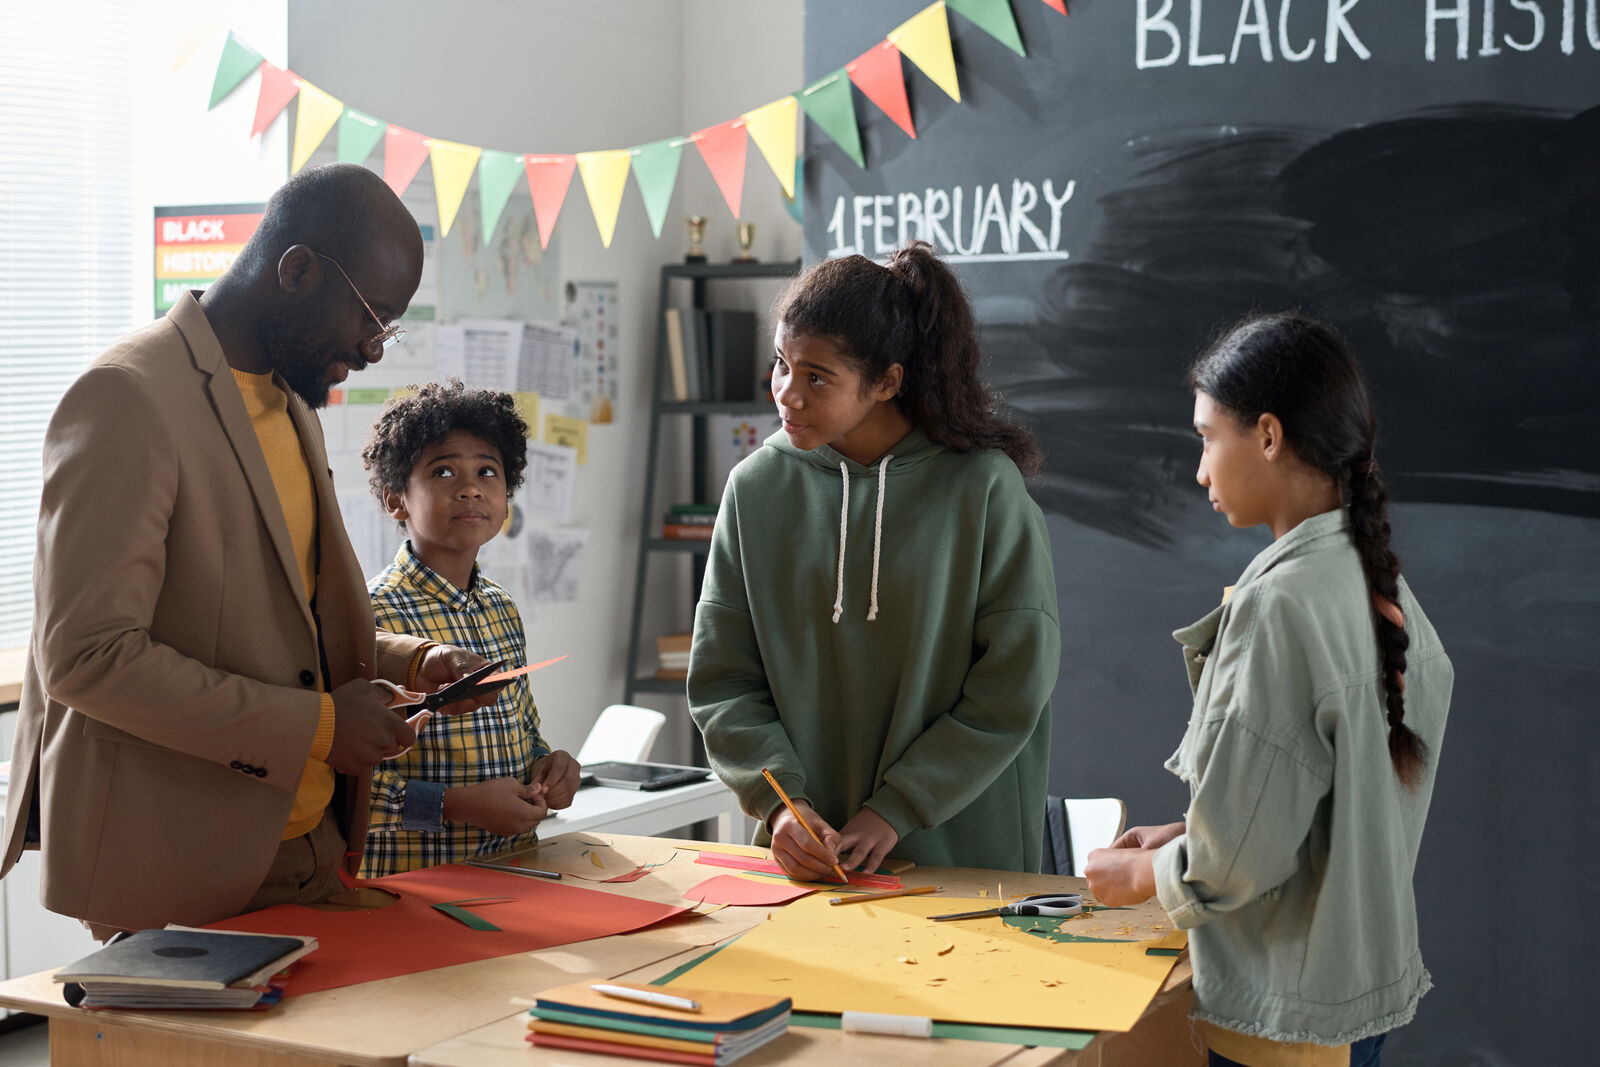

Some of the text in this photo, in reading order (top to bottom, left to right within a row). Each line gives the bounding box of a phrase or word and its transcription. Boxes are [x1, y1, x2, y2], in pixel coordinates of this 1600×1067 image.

[1136, 0, 1600, 69] BLACK HIST
[163, 220, 225, 242] BLACK
